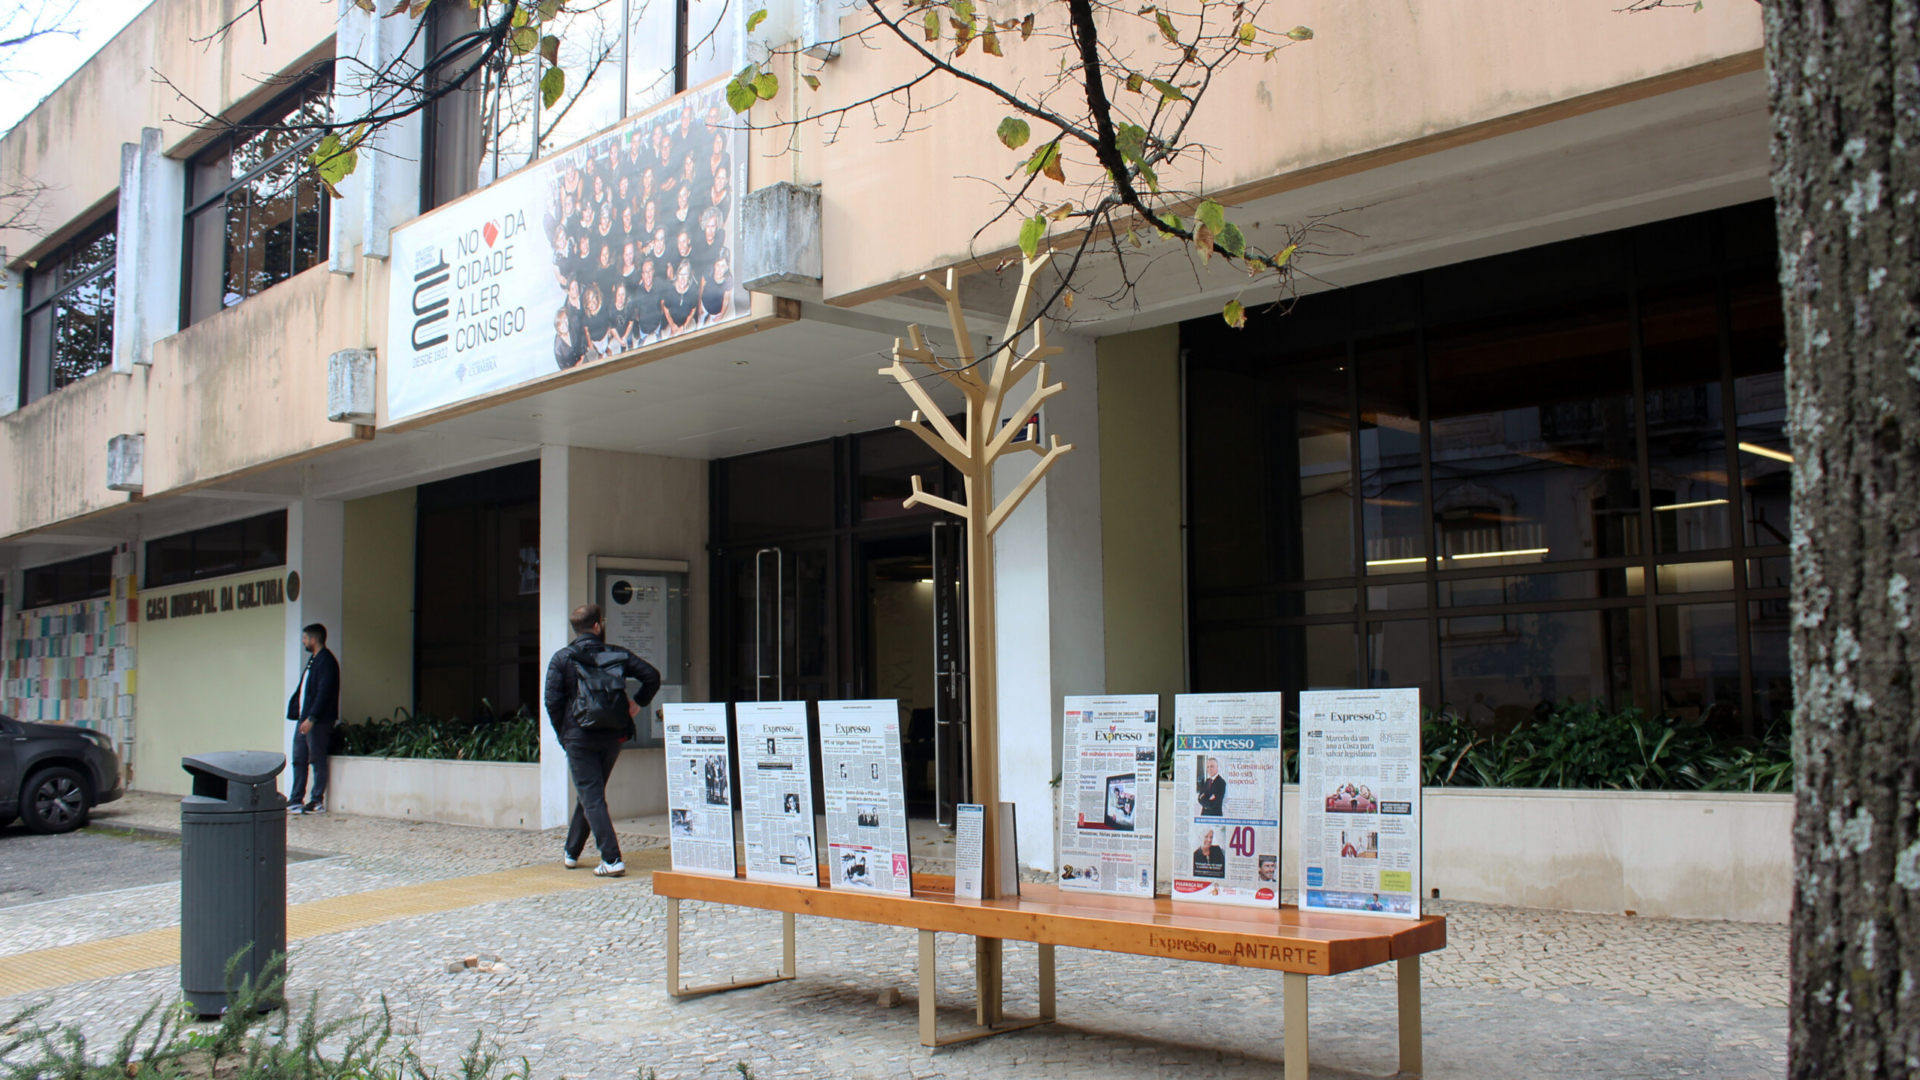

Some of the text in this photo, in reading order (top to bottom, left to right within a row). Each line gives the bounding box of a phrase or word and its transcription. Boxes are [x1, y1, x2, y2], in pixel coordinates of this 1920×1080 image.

[458, 209, 526, 259] NO DA
[457, 245, 514, 289] CIDADE
[456, 283, 500, 322] A LER
[455, 306, 526, 352] CONSIGO
[412, 347, 448, 368] DESDE 1922
[146, 578, 284, 621] CASA MUNICIPAL DA CULTURA
[1330, 711, 1375, 723] Expresso
[688, 723, 716, 734] Expresso
[763, 724, 794, 734] Expresso
[835, 723, 871, 736] Expresso
[1192, 736, 1254, 751] Expresso
[1342, 742, 1360, 750] Costa
[1360, 743, 1375, 751] para
[1344, 750, 1377, 758] legislatura
[1236, 762, 1274, 771] Constituição
[1229, 826, 1255, 857] 40
[1149, 932, 1217, 954] Expresso
[1233, 941, 1318, 965] ANTARTE
